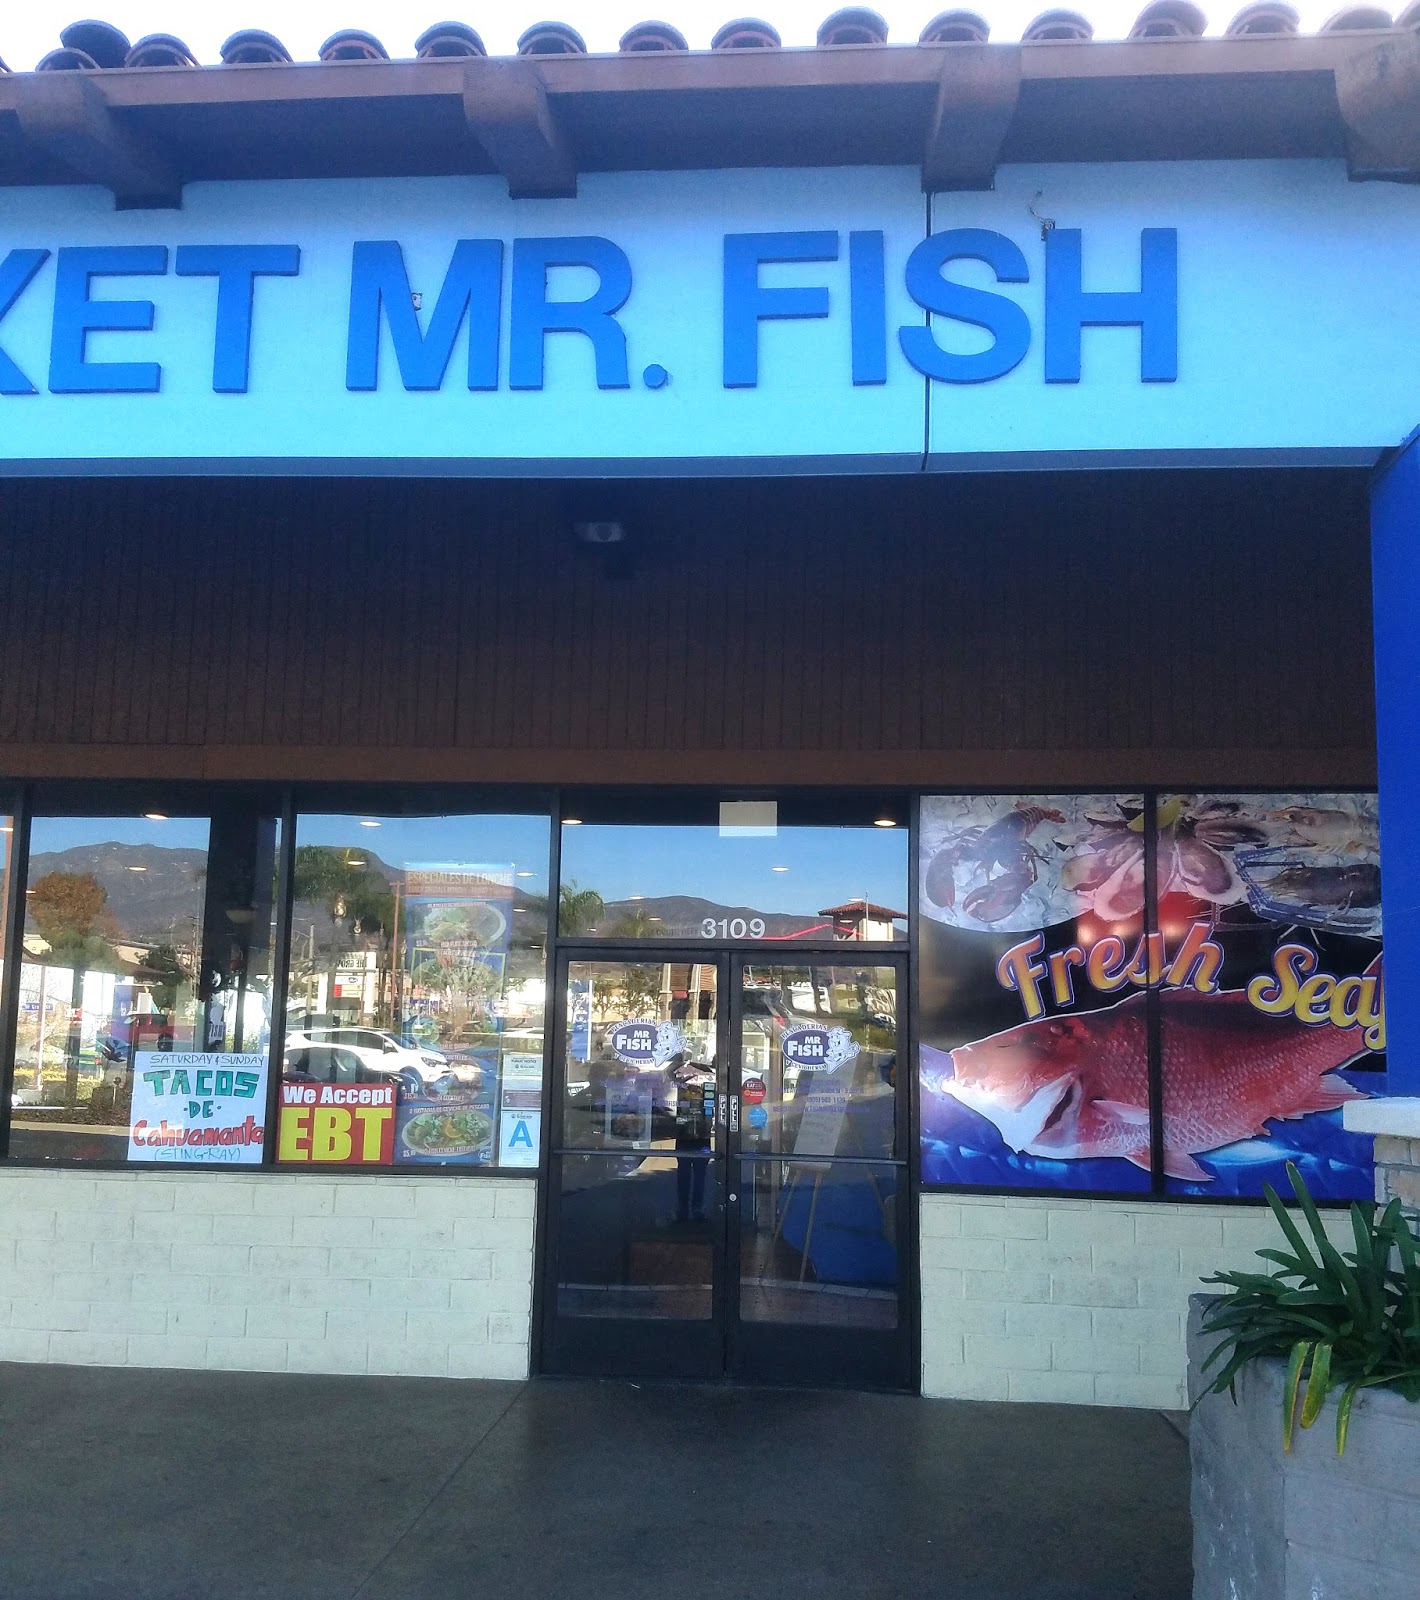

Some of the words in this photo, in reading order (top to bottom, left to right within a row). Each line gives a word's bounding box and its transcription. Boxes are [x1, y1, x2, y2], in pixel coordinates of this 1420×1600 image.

[345, 235, 669, 391] MR.
[723, 227, 1178, 389] FISH
[408, 872, 460, 885] ESPECIALES
[462, 873, 476, 885] DE
[701, 918, 766, 939] 3109
[996, 918, 1224, 1021] Fresh
[616, 1034, 652, 1051] FISH
[633, 1030, 650, 1038] MR
[804, 1036, 821, 1044] MR
[787, 1040, 824, 1057] FISH
[150, 1054, 213, 1065] SATURDAY
[220, 1055, 265, 1066] SUNDAY
[142, 1069, 260, 1098] TACOS
[283, 1085, 317, 1104] We
[320, 1086, 392, 1105] Accept
[132, 1115, 264, 1147] Cahuamanta
[278, 1107, 393, 1161] EBT
[508, 1120, 533, 1148] A
